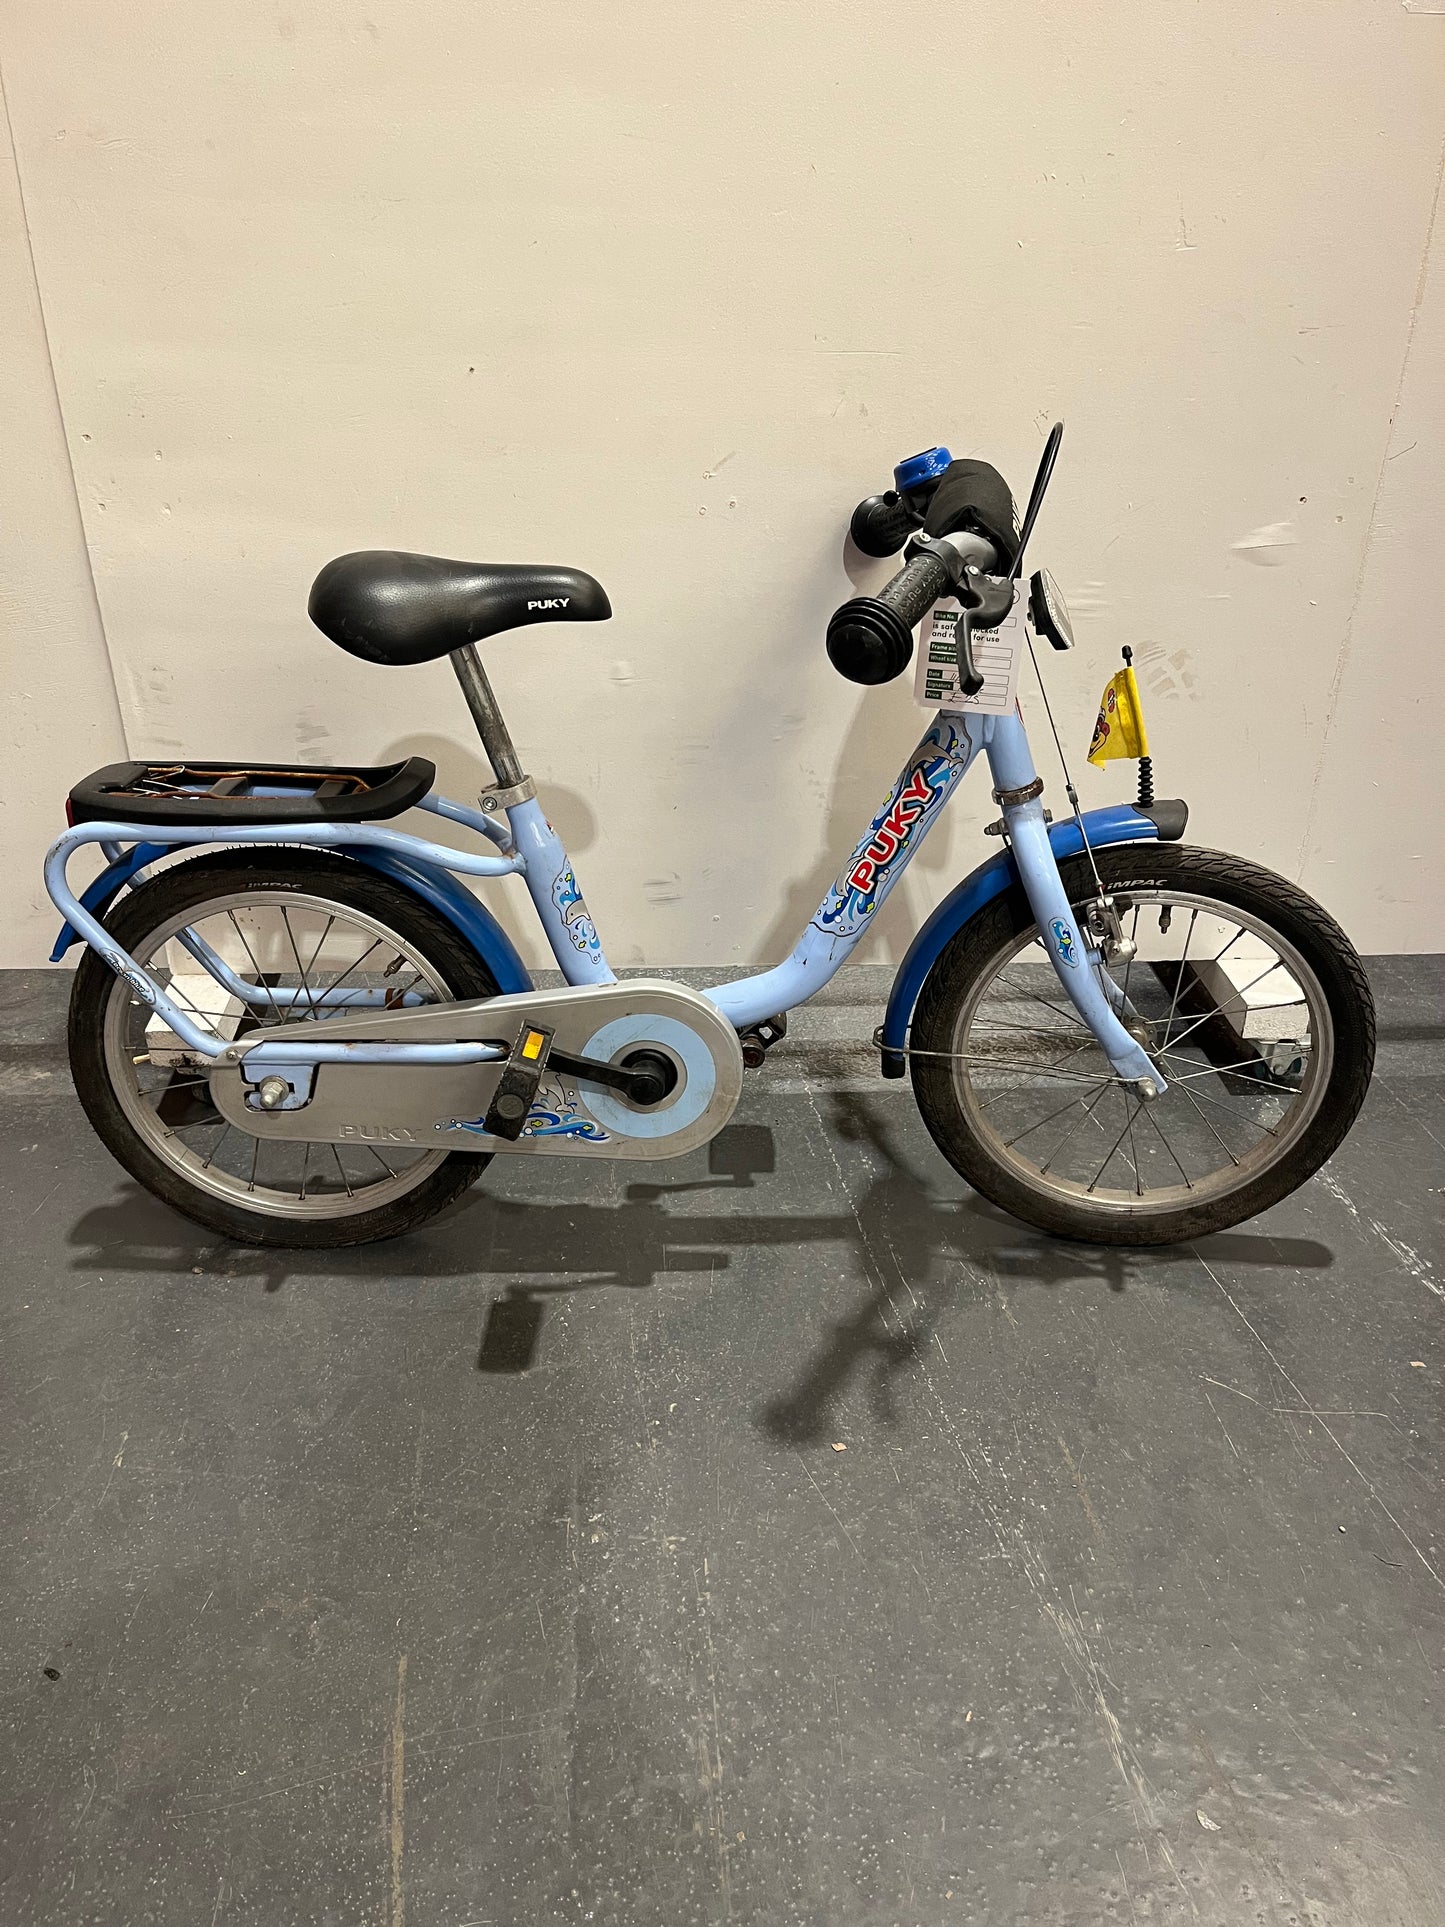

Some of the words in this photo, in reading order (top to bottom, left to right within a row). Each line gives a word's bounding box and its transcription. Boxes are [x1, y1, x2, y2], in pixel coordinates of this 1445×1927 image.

[528, 598, 570, 611] PUKY
[931, 643, 948, 651] Frame
[848, 768, 935, 894] PUKY
[339, 1124, 422, 1142] PUKY
